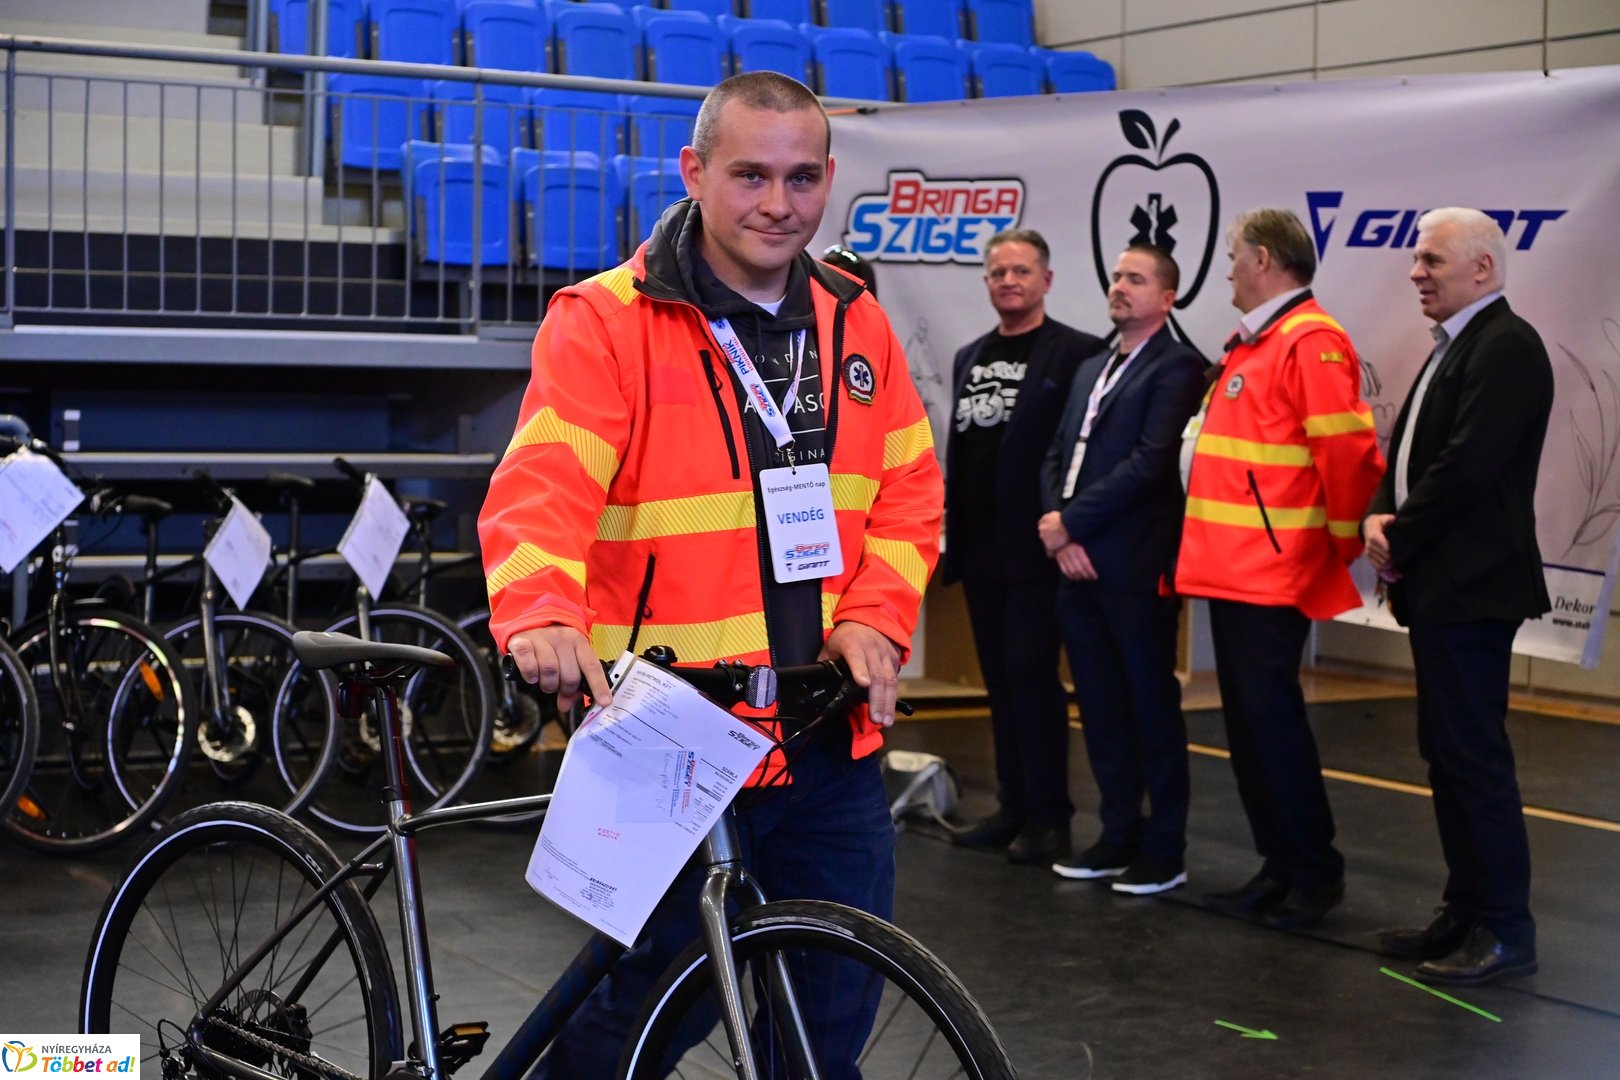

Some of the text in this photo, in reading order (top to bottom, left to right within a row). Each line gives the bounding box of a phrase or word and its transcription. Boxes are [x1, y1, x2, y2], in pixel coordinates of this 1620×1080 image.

[891, 180, 1019, 215] BRINGA
[1345, 209, 1569, 250] GIT
[726, 339, 750, 375] PIKNIK
[777, 507, 825, 525] VENDÉG
